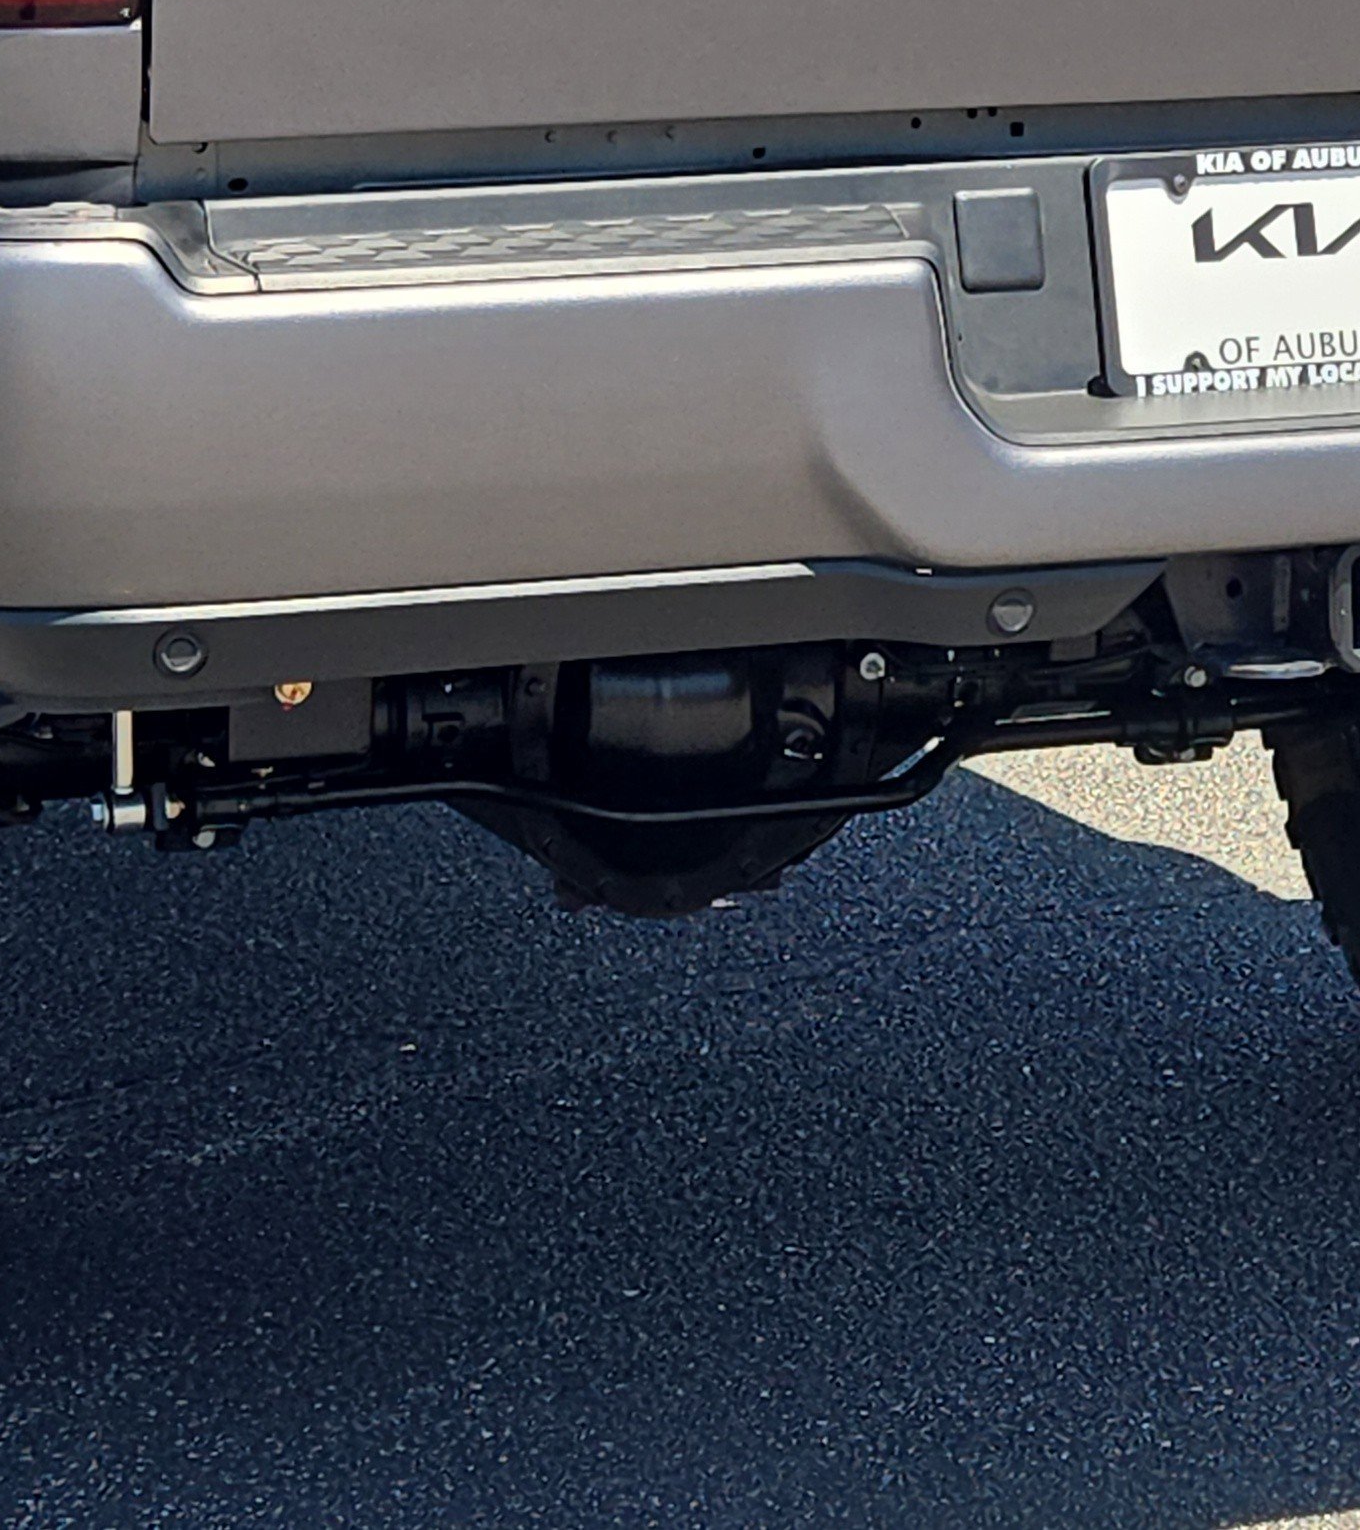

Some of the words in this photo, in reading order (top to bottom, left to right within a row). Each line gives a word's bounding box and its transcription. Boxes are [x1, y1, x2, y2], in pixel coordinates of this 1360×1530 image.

[1196, 151, 1245, 175] KIA
[1250, 149, 1287, 171] OF
[1219, 336, 1260, 365] OF
[1136, 376, 1147, 398] I
[1152, 368, 1261, 396] SUPPORT
[1265, 366, 1303, 388] MY
